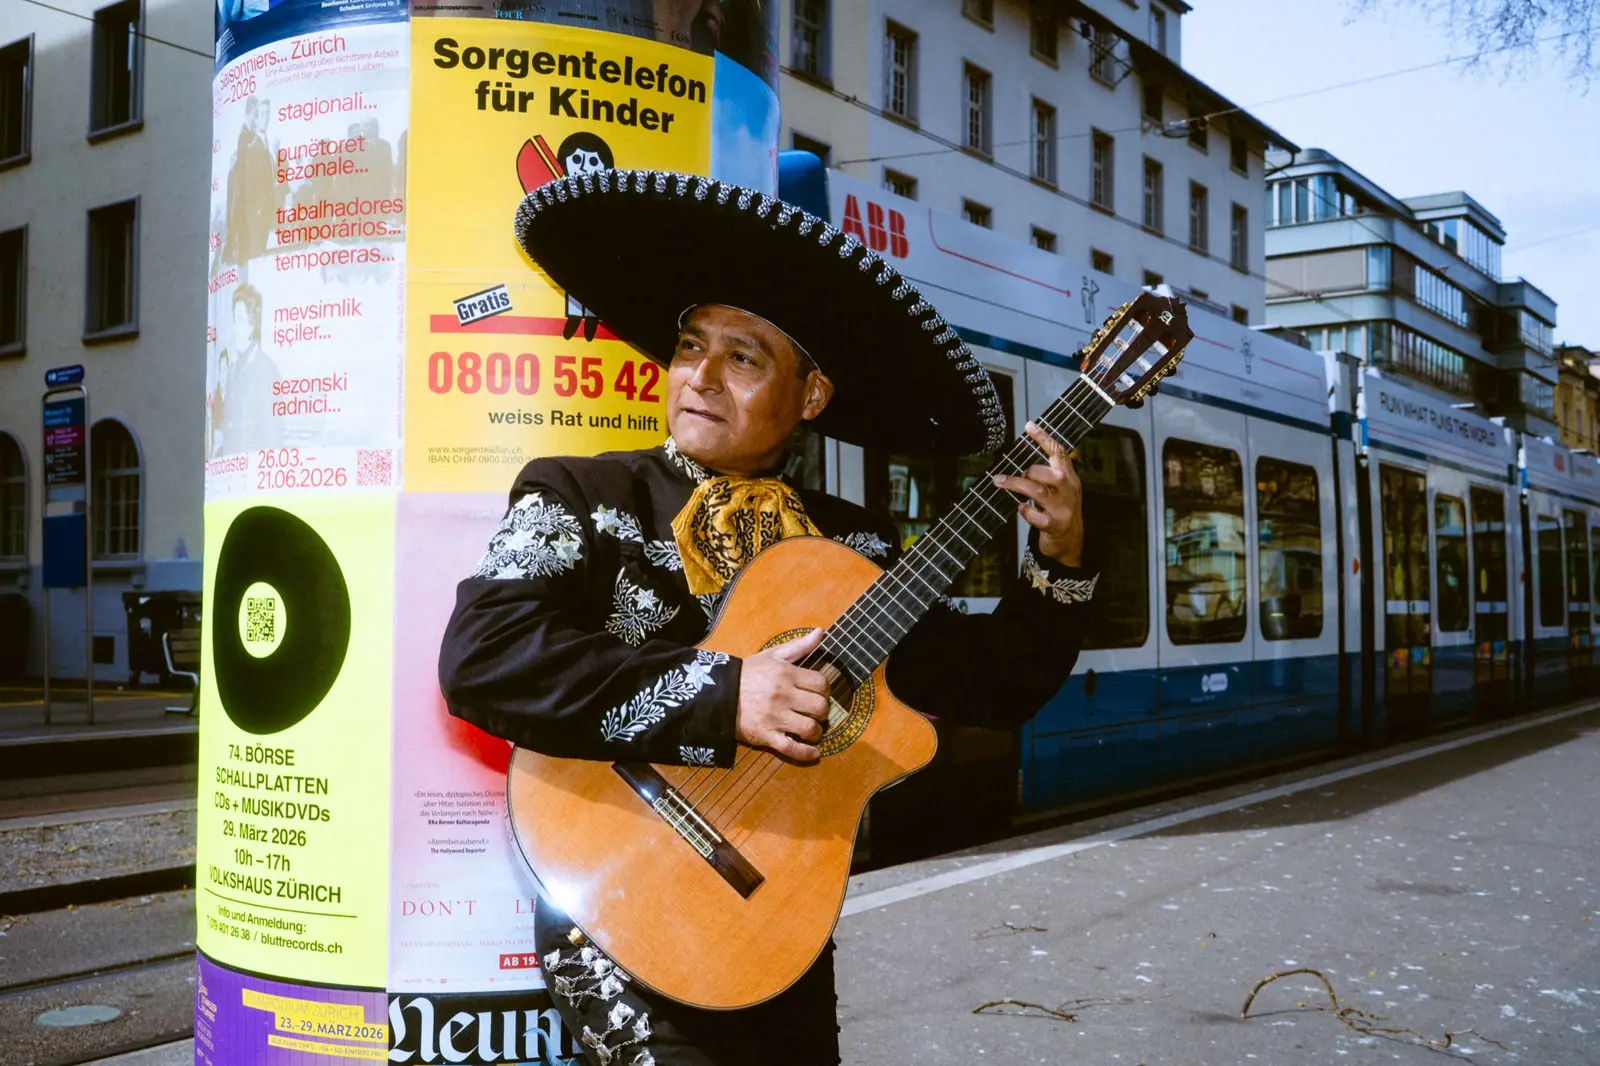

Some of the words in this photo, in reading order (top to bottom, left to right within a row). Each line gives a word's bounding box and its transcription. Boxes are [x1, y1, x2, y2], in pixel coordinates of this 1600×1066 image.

[494, 10, 523, 20] TOUR
[291, 34, 346, 60] Zürich
[278, 60, 316, 74] Ausstellung
[336, 52, 372, 63] sichtbare
[374, 50, 400, 59] Arbeit
[314, 65, 356, 79] gemachtes
[358, 62, 384, 72] Leben
[433, 38, 706, 104] Sorgentelefon
[278, 92, 378, 122] stagionali...
[475, 80, 534, 114] für
[550, 86, 674, 134] Kinder
[277, 135, 366, 167] punëtoret
[276, 156, 368, 184] sezonale...
[276, 197, 404, 224] trabalhadores
[276, 218, 400, 245] temporários...
[842, 194, 909, 259] ABB
[274, 247, 395, 272] temporeras...
[274, 298, 362, 324] mevsimlik
[456, 290, 510, 321] Gratis
[274, 323, 331, 348] işçiler...
[272, 372, 348, 396] sezonski
[428, 351, 540, 396] 0800
[553, 355, 604, 399] 55
[614, 360, 660, 403] 42
[272, 395, 341, 417] radnici...
[1380, 391, 1402, 415] RUN
[1402, 400, 1428, 424] WHAT
[488, 409, 544, 425] weiss
[550, 410, 583, 428] Rat
[589, 413, 622, 430] und
[628, 414, 659, 432] hilft
[428, 455, 450, 464] IBAN
[452, 455, 476, 464] CH97
[257, 468, 347, 490] 21.06.2026
[228, 744, 243, 761] 74.
[246, 743, 295, 766] BÖRSE
[216, 766, 328, 795] SCHALLPLATTEN
[214, 791, 230, 810] CDs
[232, 802, 238, 812] +
[242, 797, 330, 822] MUSIKDVDs
[431, 810, 461, 818] Verlangen
[223, 820, 236, 838] 29.
[240, 822, 268, 843] März
[272, 828, 306, 847] 2026
[209, 864, 272, 896] VOLKSHAUS
[276, 877, 341, 904] ZÜRICH
[218, 905, 230, 920] Info
[232, 909, 246, 924] und
[248, 913, 306, 935] Anmeldung:
[402, 900, 477, 916] DON'T
[218, 920, 229, 936] 401
[230, 923, 240, 938] 26
[240, 926, 250, 941] 38
[261, 932, 343, 954] bluttrecords.ch
[503, 957, 519, 966] AB
[522, 956, 538, 966] 19.
[318, 1020, 352, 1037] MÄRZ
[354, 1026, 384, 1040] 2026
[388, 996, 584, 1062] Neun
